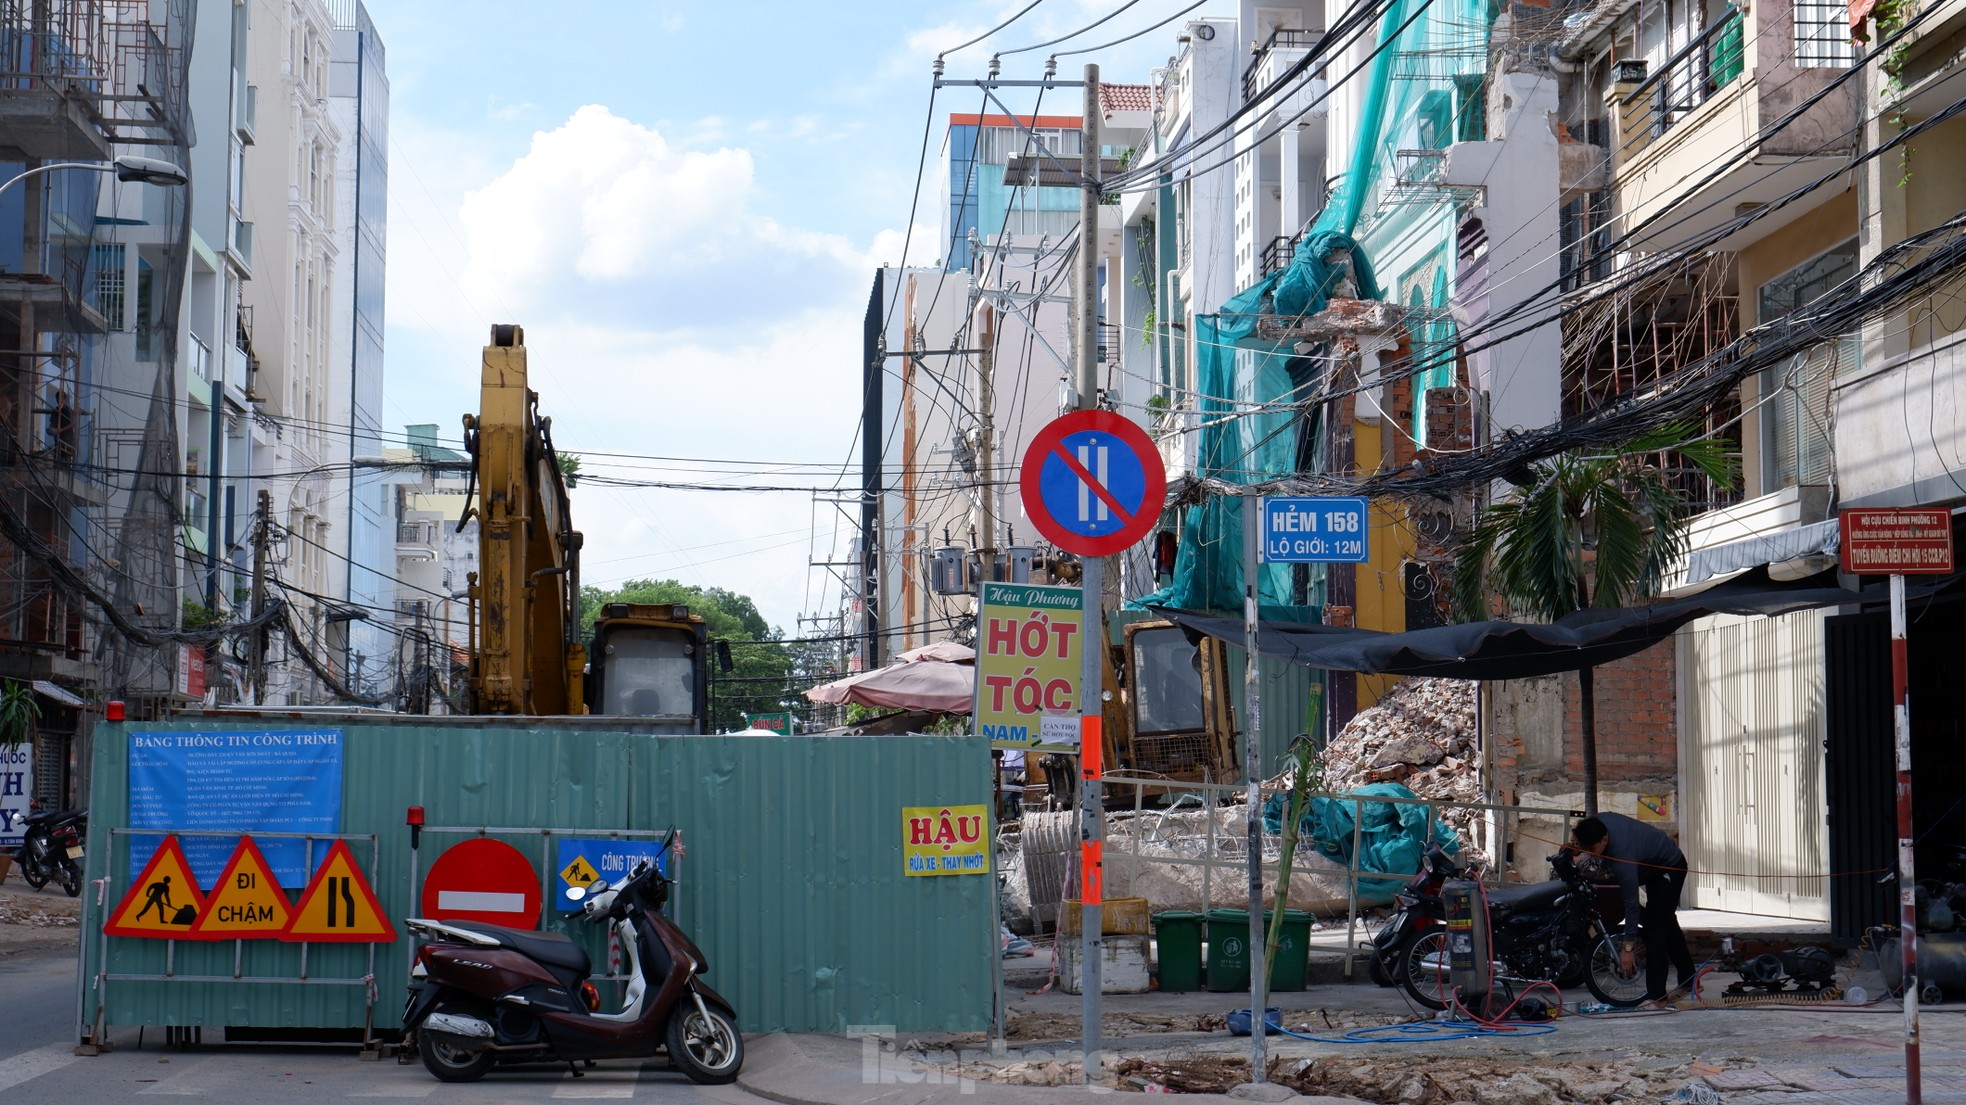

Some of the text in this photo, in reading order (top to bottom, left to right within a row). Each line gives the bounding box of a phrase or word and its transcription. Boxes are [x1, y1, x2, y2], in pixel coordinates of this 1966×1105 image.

[1272, 504, 1359, 533] HẺM 158
[1861, 514, 1870, 527] HỘI
[1882, 513, 1898, 525] CHIẾN
[1898, 516, 1910, 525] BINH
[1931, 516, 1938, 525] 12
[1270, 536, 1361, 557] LỘ GIỚI: 12M
[1852, 543, 1870, 564] TUYẾN
[1870, 545, 1888, 564] ĐƯỜNG
[1888, 541, 1901, 564] ĐIỂM
[1902, 548, 1911, 563] CHI
[1911, 544, 1921, 567] HỘI
[1921, 548, 1927, 563] 15
[990, 586, 1079, 609] Hậu Phương
[988, 611, 1077, 659] HỚT
[985, 668, 1073, 715] TÓC
[752, 715, 785, 730] BÚN CÁ
[136, 732, 337, 747] BẢNG THÔNG TIN CÔNG TRÌNH
[982, 724, 1028, 742] NAM
[909, 808, 982, 851] HẬU
[602, 852, 623, 871] CÔNG
[910, 853, 924, 871] RỬA
[926, 856, 937, 871] XE
[942, 856, 962, 871] THAY
[964, 851, 984, 870] NHỚT
[236, 872, 256, 890] ĐI
[218, 902, 274, 924] CHẬM
[452, 958, 493, 970] LEAD
